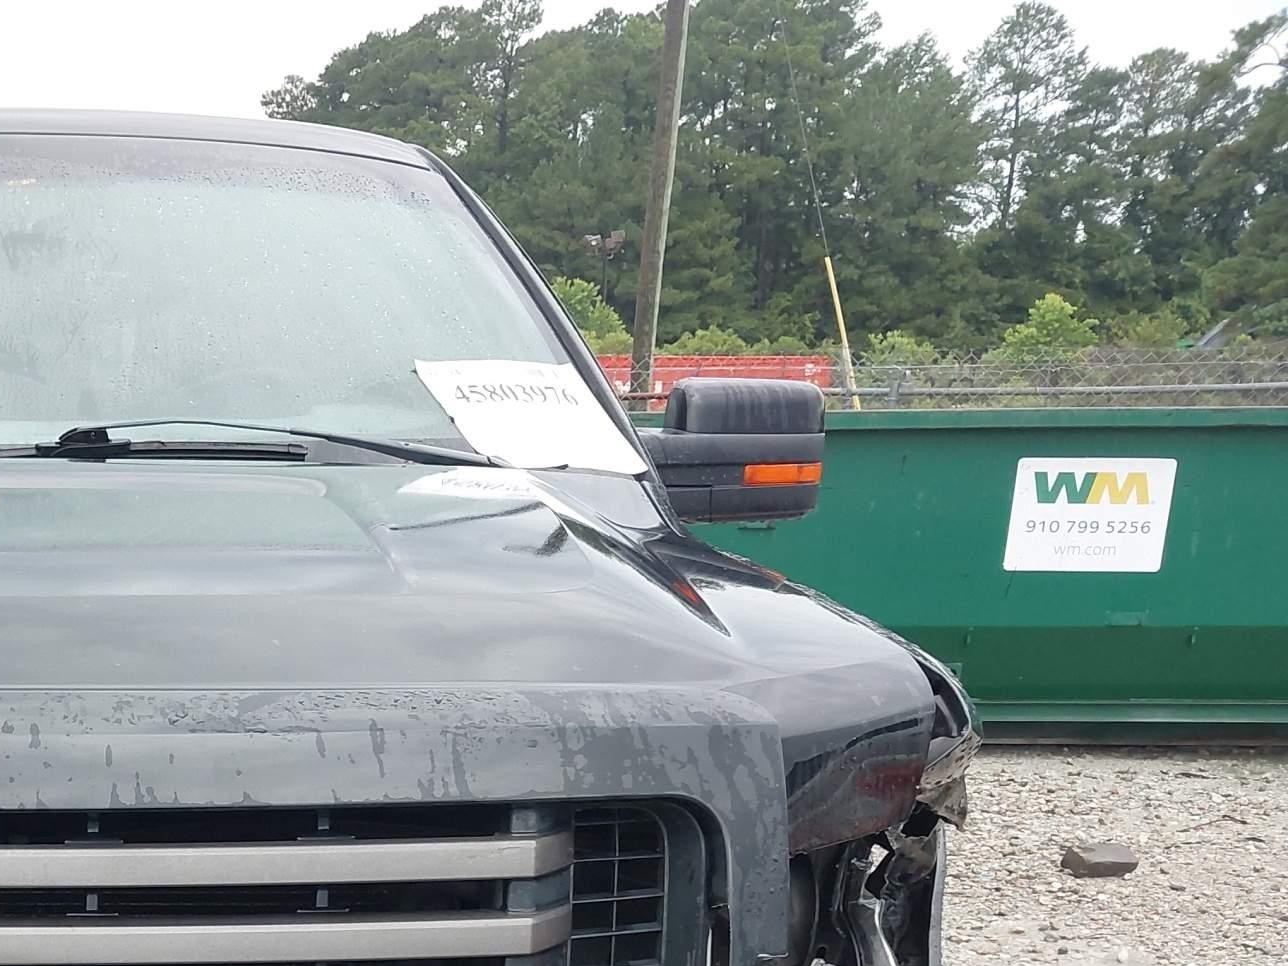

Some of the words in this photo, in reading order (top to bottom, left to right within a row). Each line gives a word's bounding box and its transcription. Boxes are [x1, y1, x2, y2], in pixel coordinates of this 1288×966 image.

[454, 383, 579, 406] 45803976
[1034, 471, 1151, 504] WM
[1025, 519, 1060, 534] 910
[1067, 520, 1100, 534] 799
[1106, 520, 1152, 534] 5256
[1053, 544, 1117, 556] wm.com
